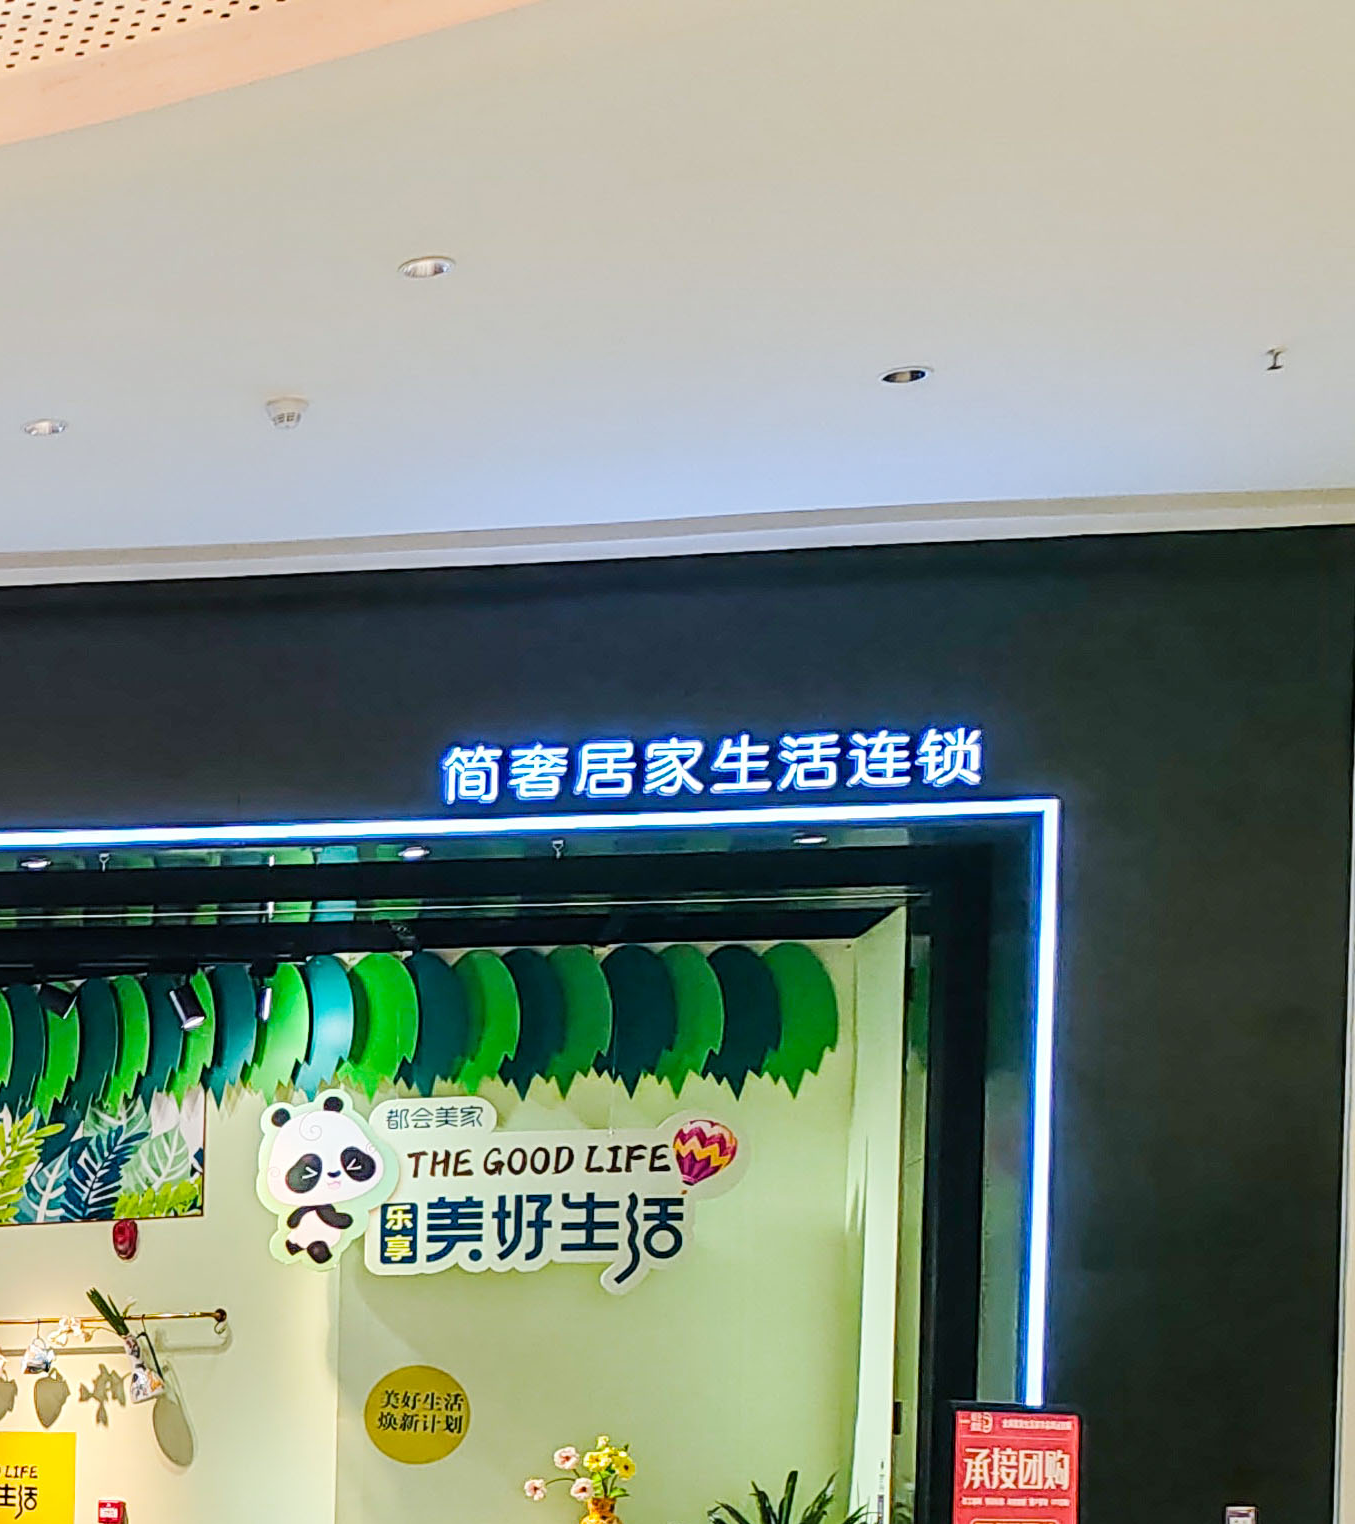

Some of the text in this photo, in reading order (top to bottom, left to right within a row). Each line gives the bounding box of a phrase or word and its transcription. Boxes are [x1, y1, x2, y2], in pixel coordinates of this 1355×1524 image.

[443, 726, 984, 805] 简奢居家生活连锁
[385, 1104, 485, 1131] 都会美家
[407, 1142, 672, 1178] THE GOOD LIFE
[384, 1203, 414, 1263] 乐享
[425, 1192, 686, 1284] 美好生活
[378, 1389, 465, 1412] 美好生活
[377, 1412, 464, 1434] 焕新计划
[4, 1465, 38, 1479] LIFE
[962, 1447, 1071, 1491] 承接团购
